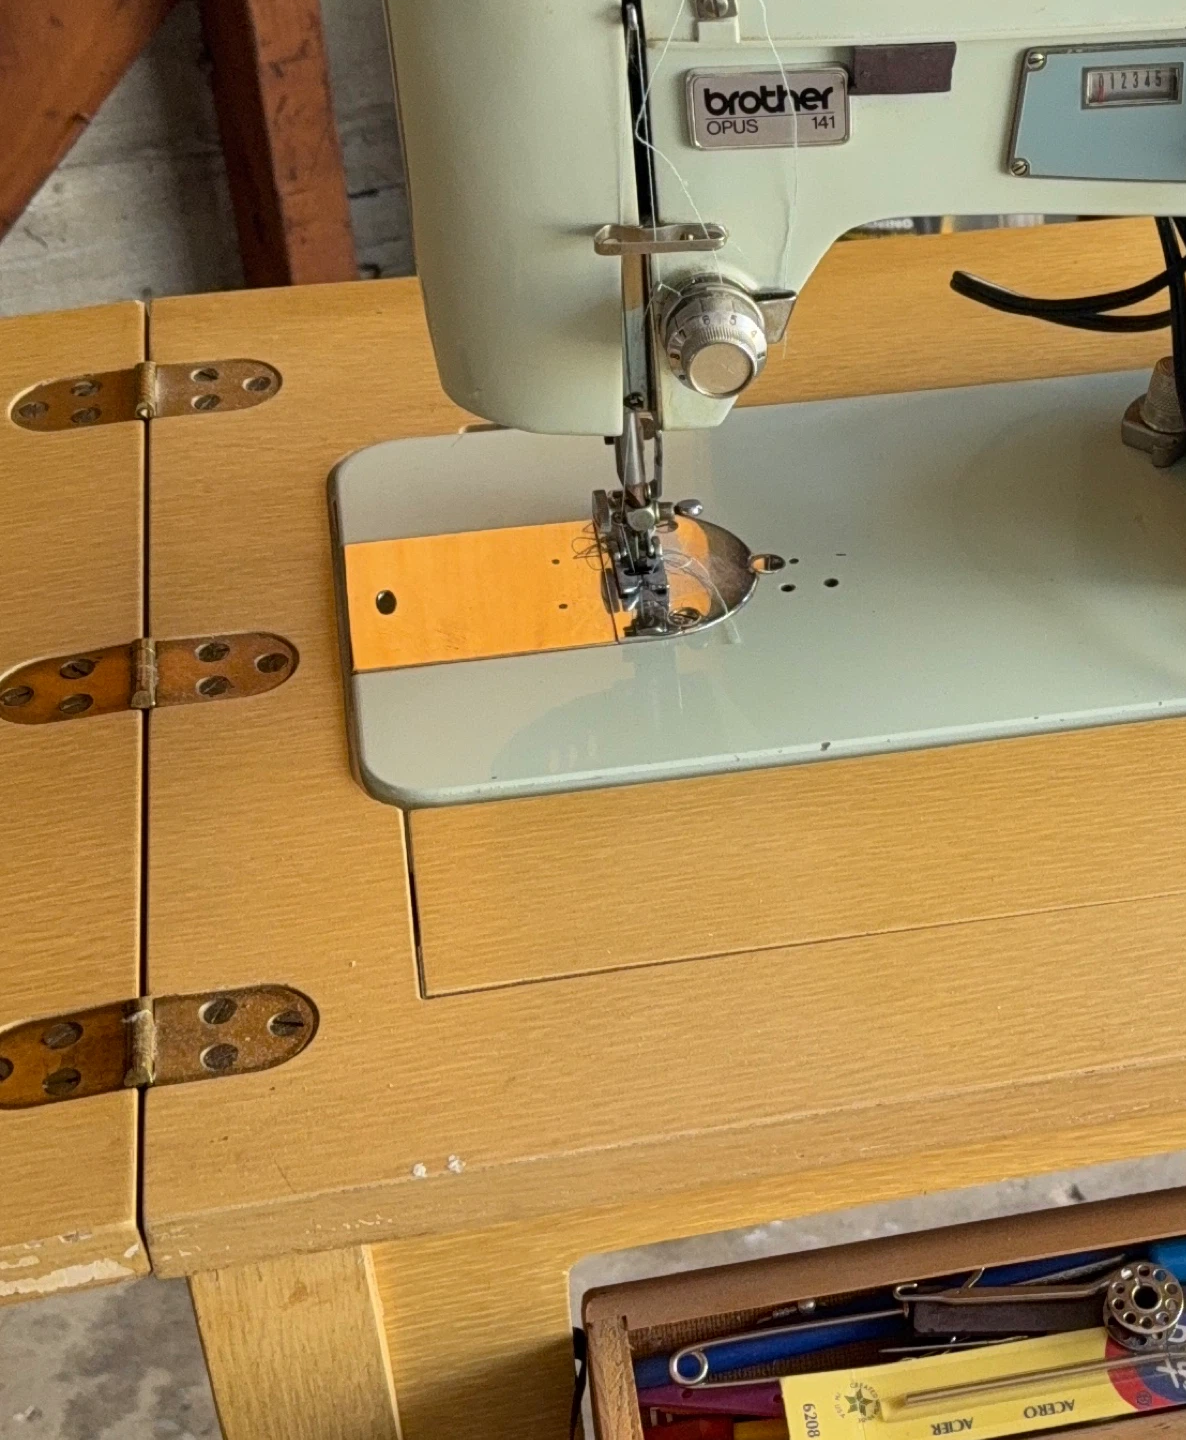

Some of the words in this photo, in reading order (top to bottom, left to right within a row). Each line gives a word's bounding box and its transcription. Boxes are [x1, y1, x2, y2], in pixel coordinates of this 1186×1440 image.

[703, 84, 834, 116] brother
[706, 118, 760, 136] OPUS
[810, 115, 836, 130] 141
[1023, 1398, 1075, 1419] ACERO
[802, 1403, 821, 1438] 6208
[930, 1416, 974, 1436] ACIER
